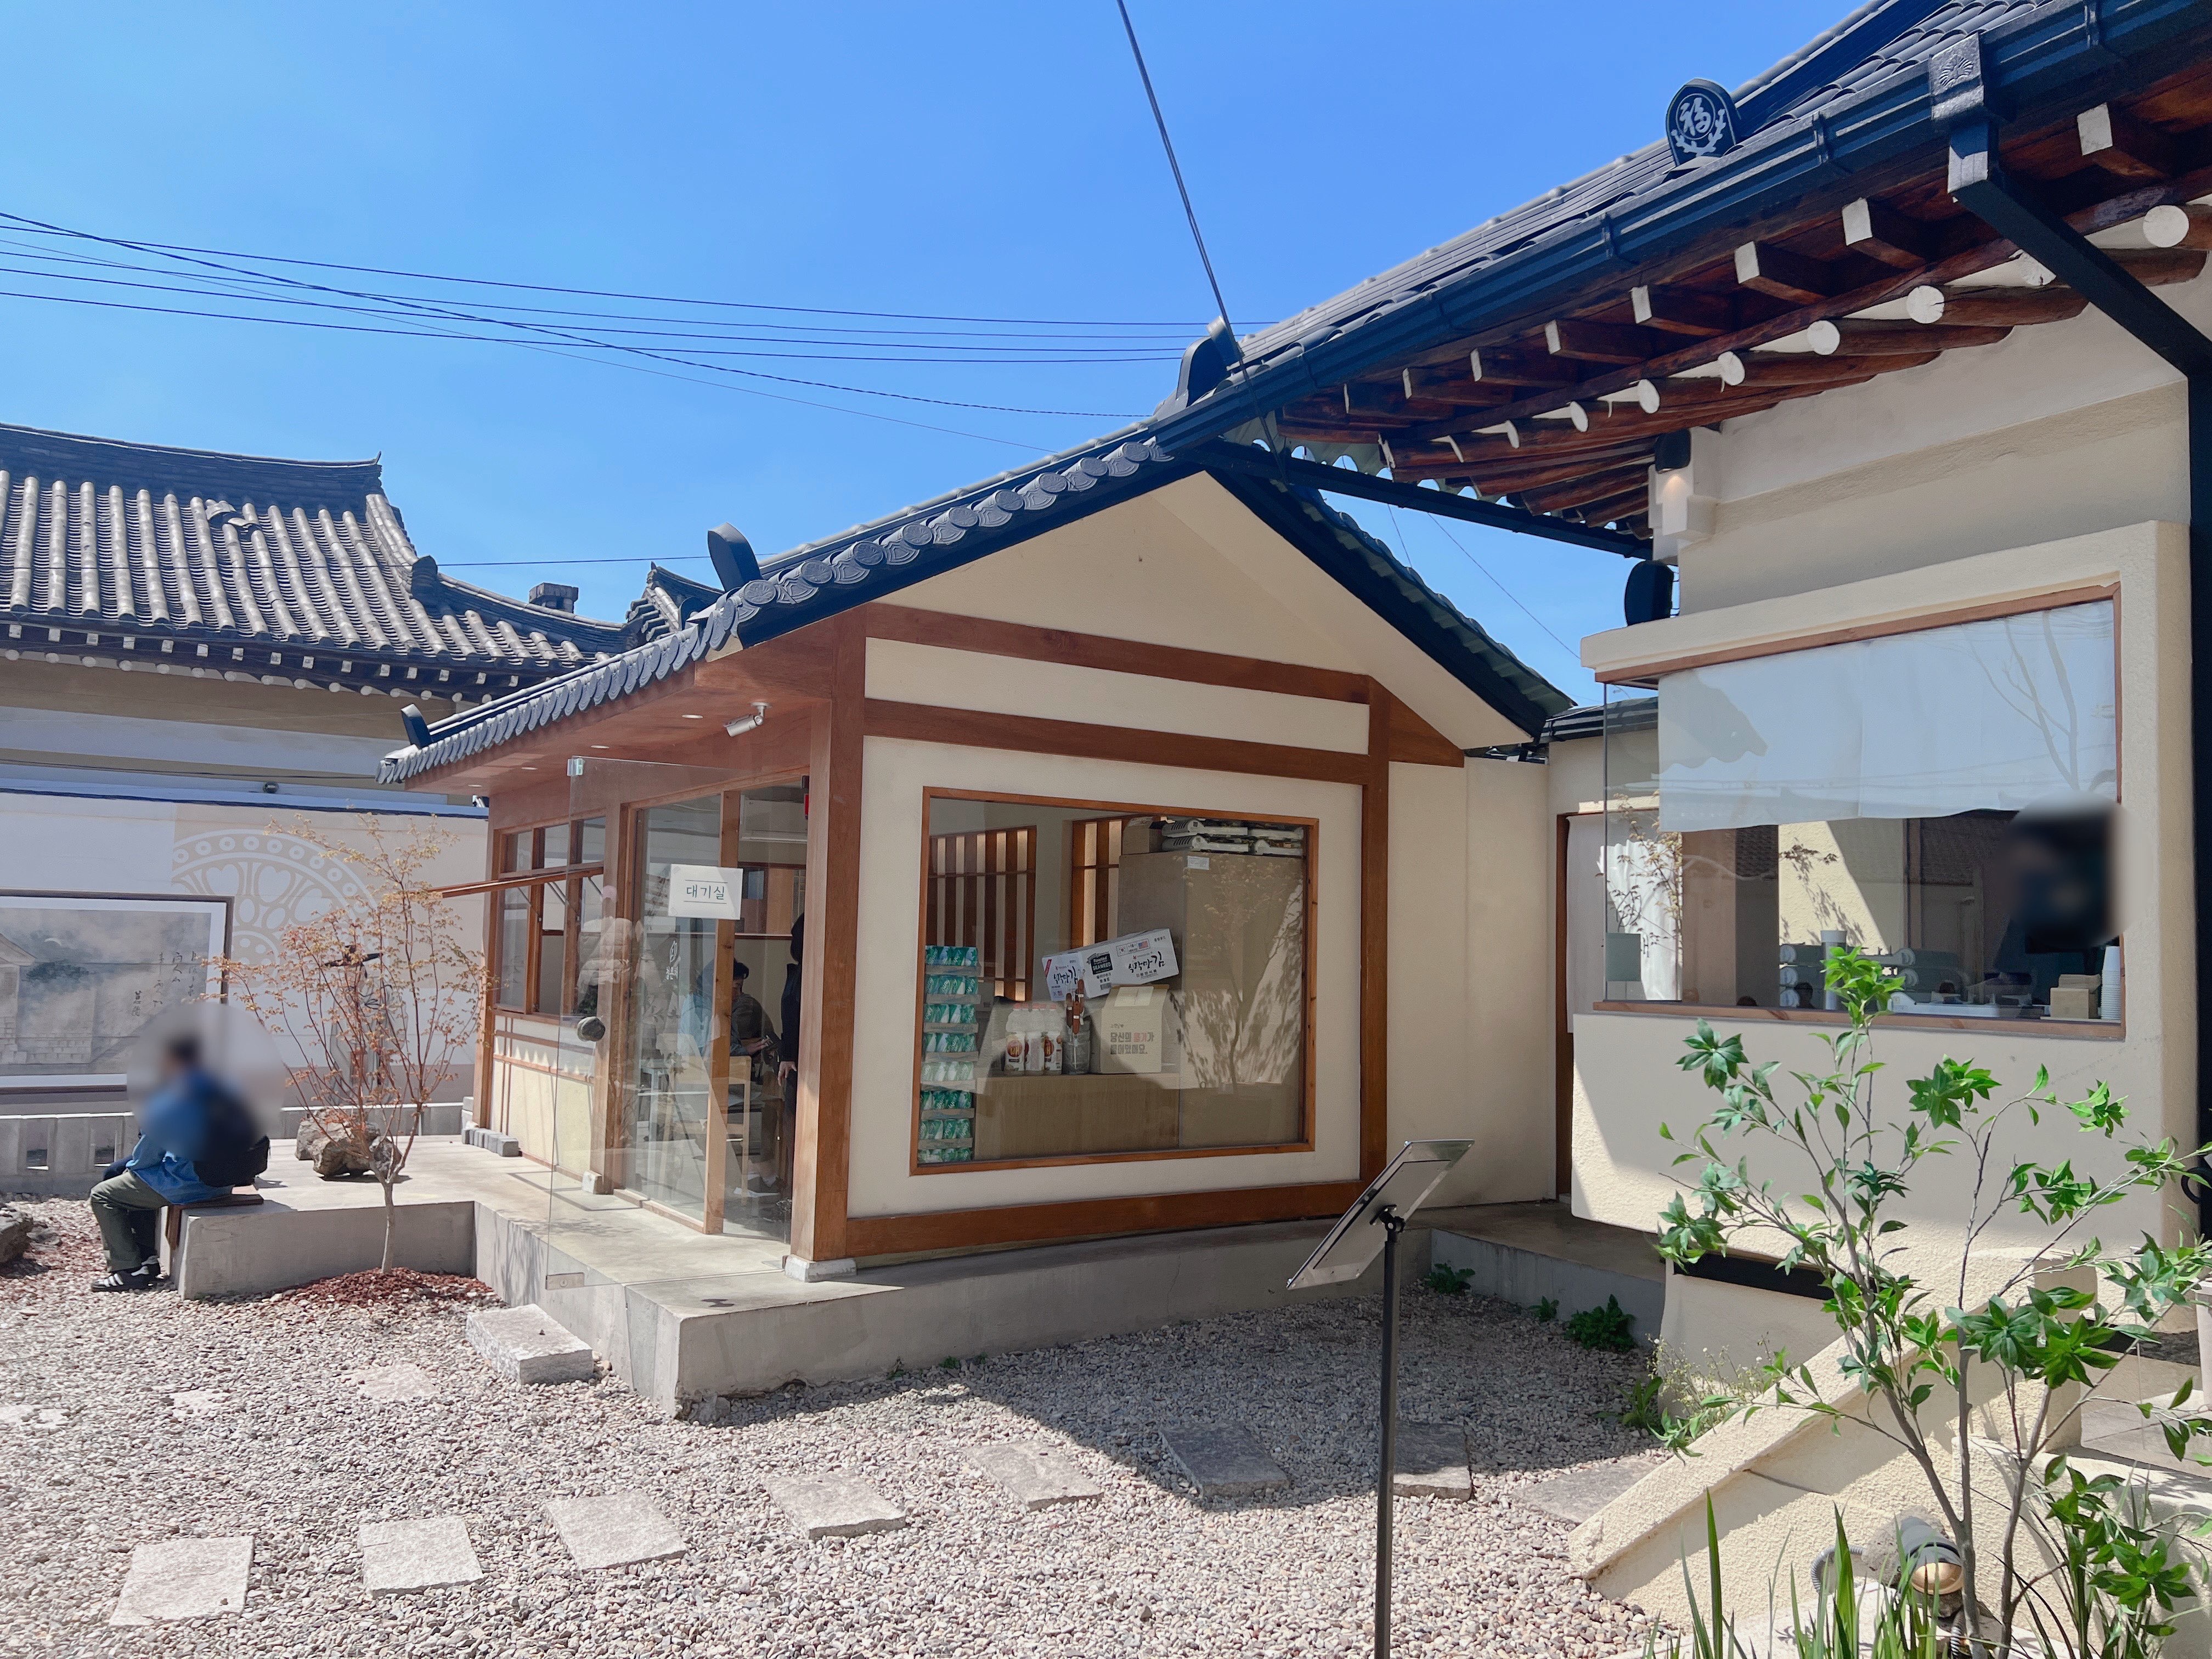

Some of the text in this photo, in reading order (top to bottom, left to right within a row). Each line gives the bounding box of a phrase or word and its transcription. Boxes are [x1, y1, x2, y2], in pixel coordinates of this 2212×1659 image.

[1679, 97, 1712, 136] 福
[686, 884, 725, 900] 대기실
[1092, 961, 1111, 971] SEAWEED
[1110, 1031, 1131, 1043] 당신의
